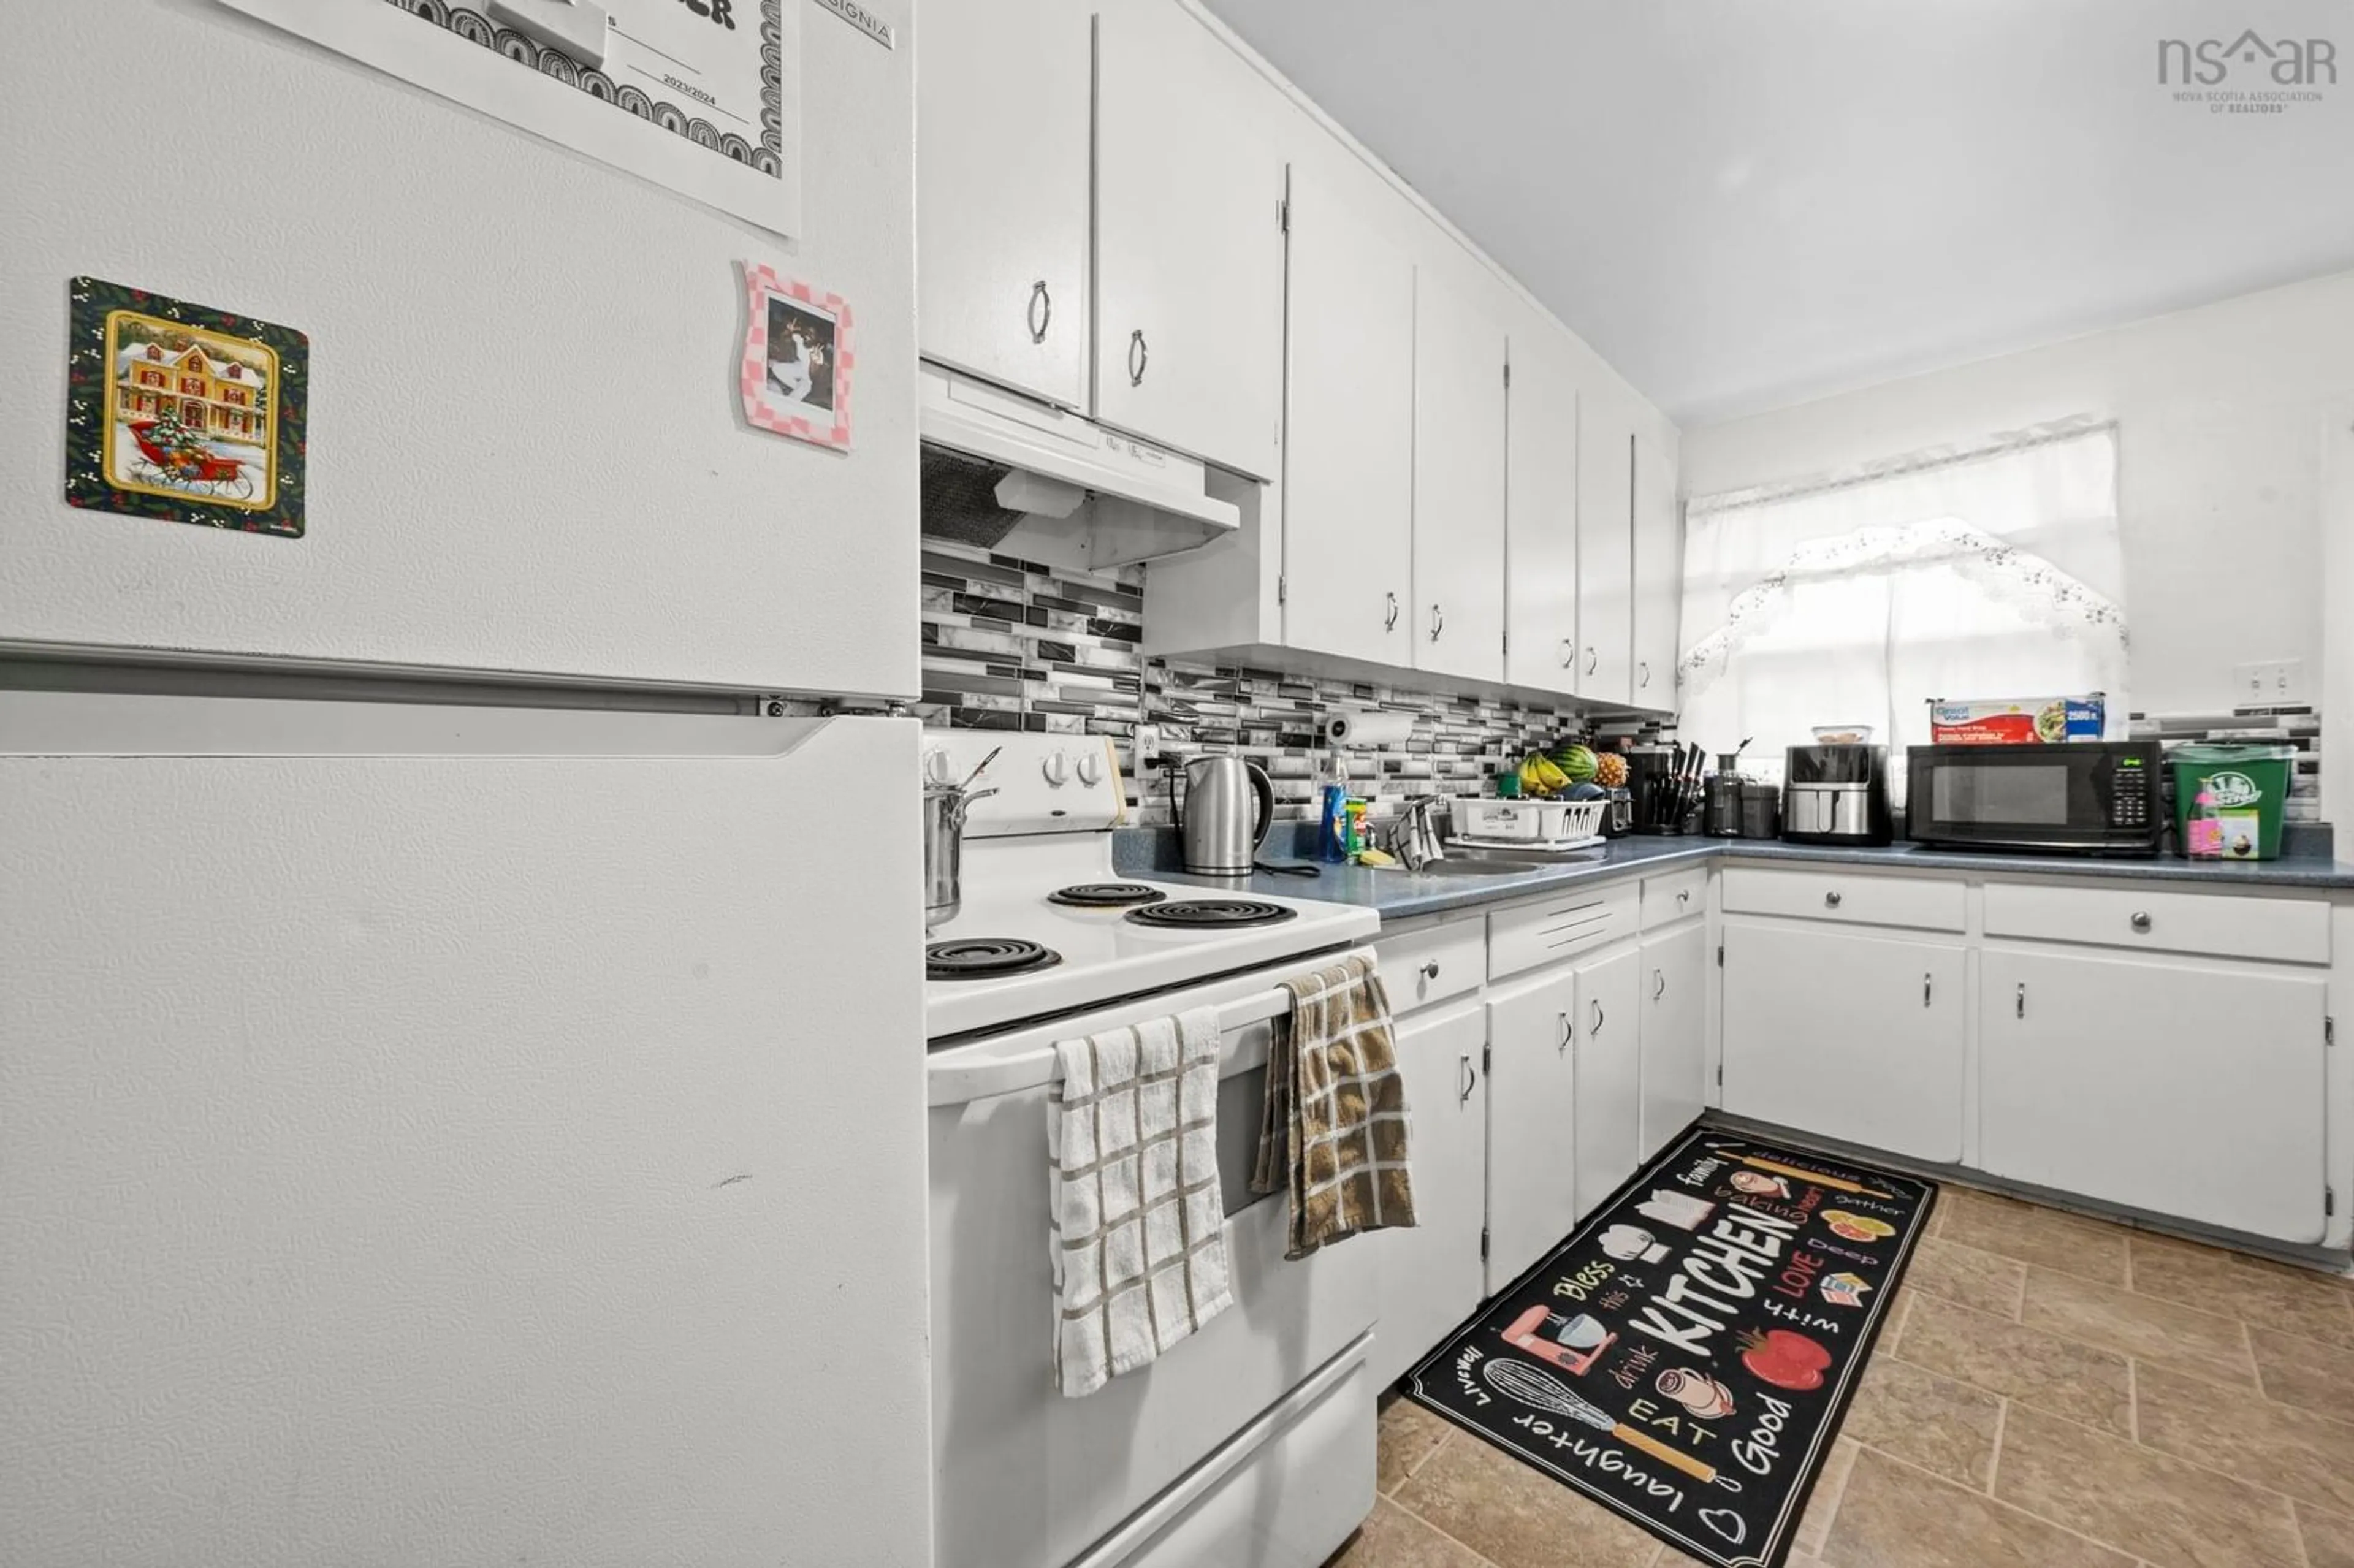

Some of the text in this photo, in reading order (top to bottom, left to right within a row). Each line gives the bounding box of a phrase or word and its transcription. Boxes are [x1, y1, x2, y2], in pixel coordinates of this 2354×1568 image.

[663, 74, 716, 105] 2023/2024
[1675, 1156, 1729, 1187] family
[1714, 1185, 1808, 1225] baking
[1835, 1194, 1906, 1216] gather
[1807, 1238, 1880, 1266] Deep
[1553, 1260, 1616, 1301] Bless
[1628, 1202, 1800, 1357] KITCHEN
[1773, 1249, 1825, 1299] LOVE
[1599, 1289, 1630, 1311] this
[1764, 1298, 1840, 1335] with
[1608, 1344, 1659, 1390] drink
[1628, 1398, 1718, 1445] EAT
[1732, 1391, 1792, 1476] Good
[1512, 1412, 1684, 1513] laughter
